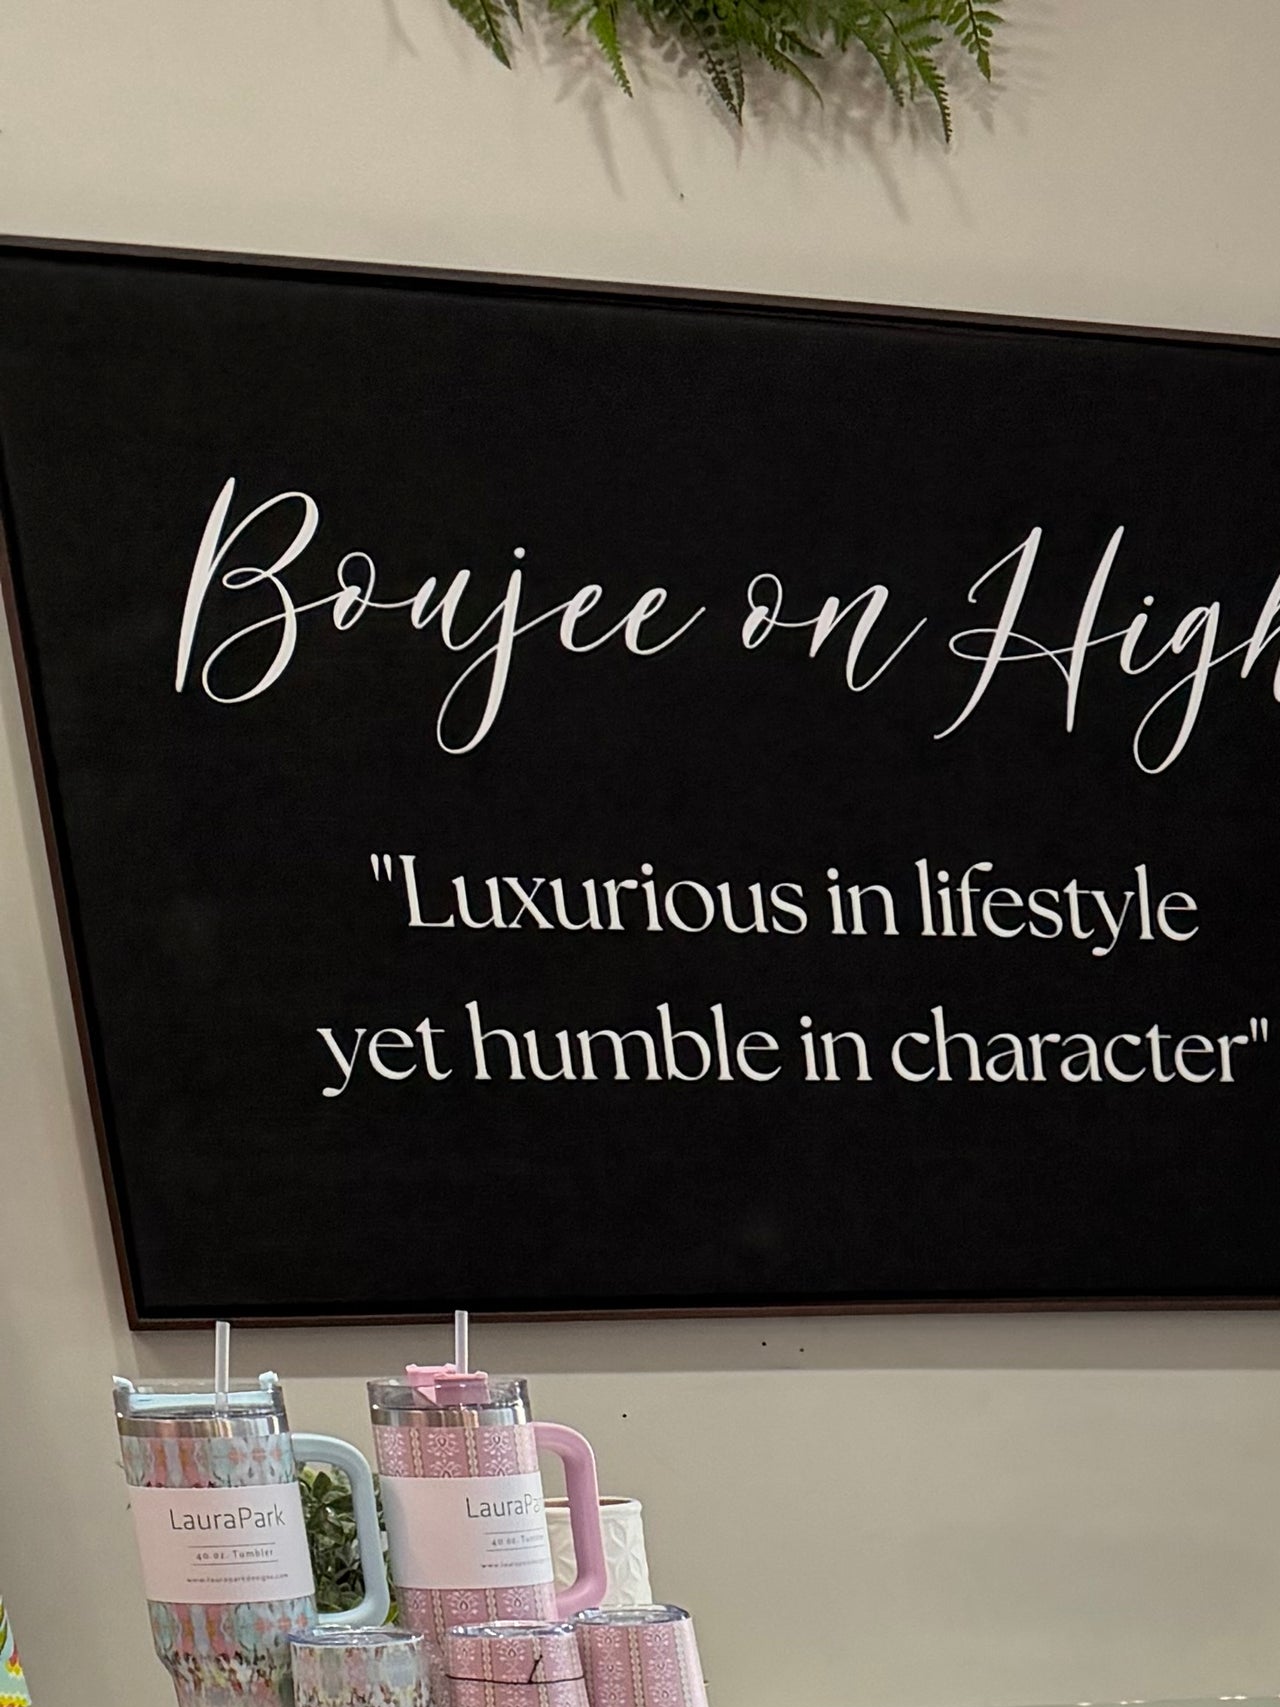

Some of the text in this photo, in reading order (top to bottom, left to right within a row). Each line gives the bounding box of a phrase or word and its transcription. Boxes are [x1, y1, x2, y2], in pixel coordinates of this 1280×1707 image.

[175, 477, 705, 754] Boujee
[742, 574, 927, 691] on
[371, 854, 1198, 956] "Luxurious in lifestyle
[317, 1001, 1267, 1097] yet humble in character"
[169, 1504, 286, 1530] LauraPark
[232, 1548, 274, 1559] Tumbler
